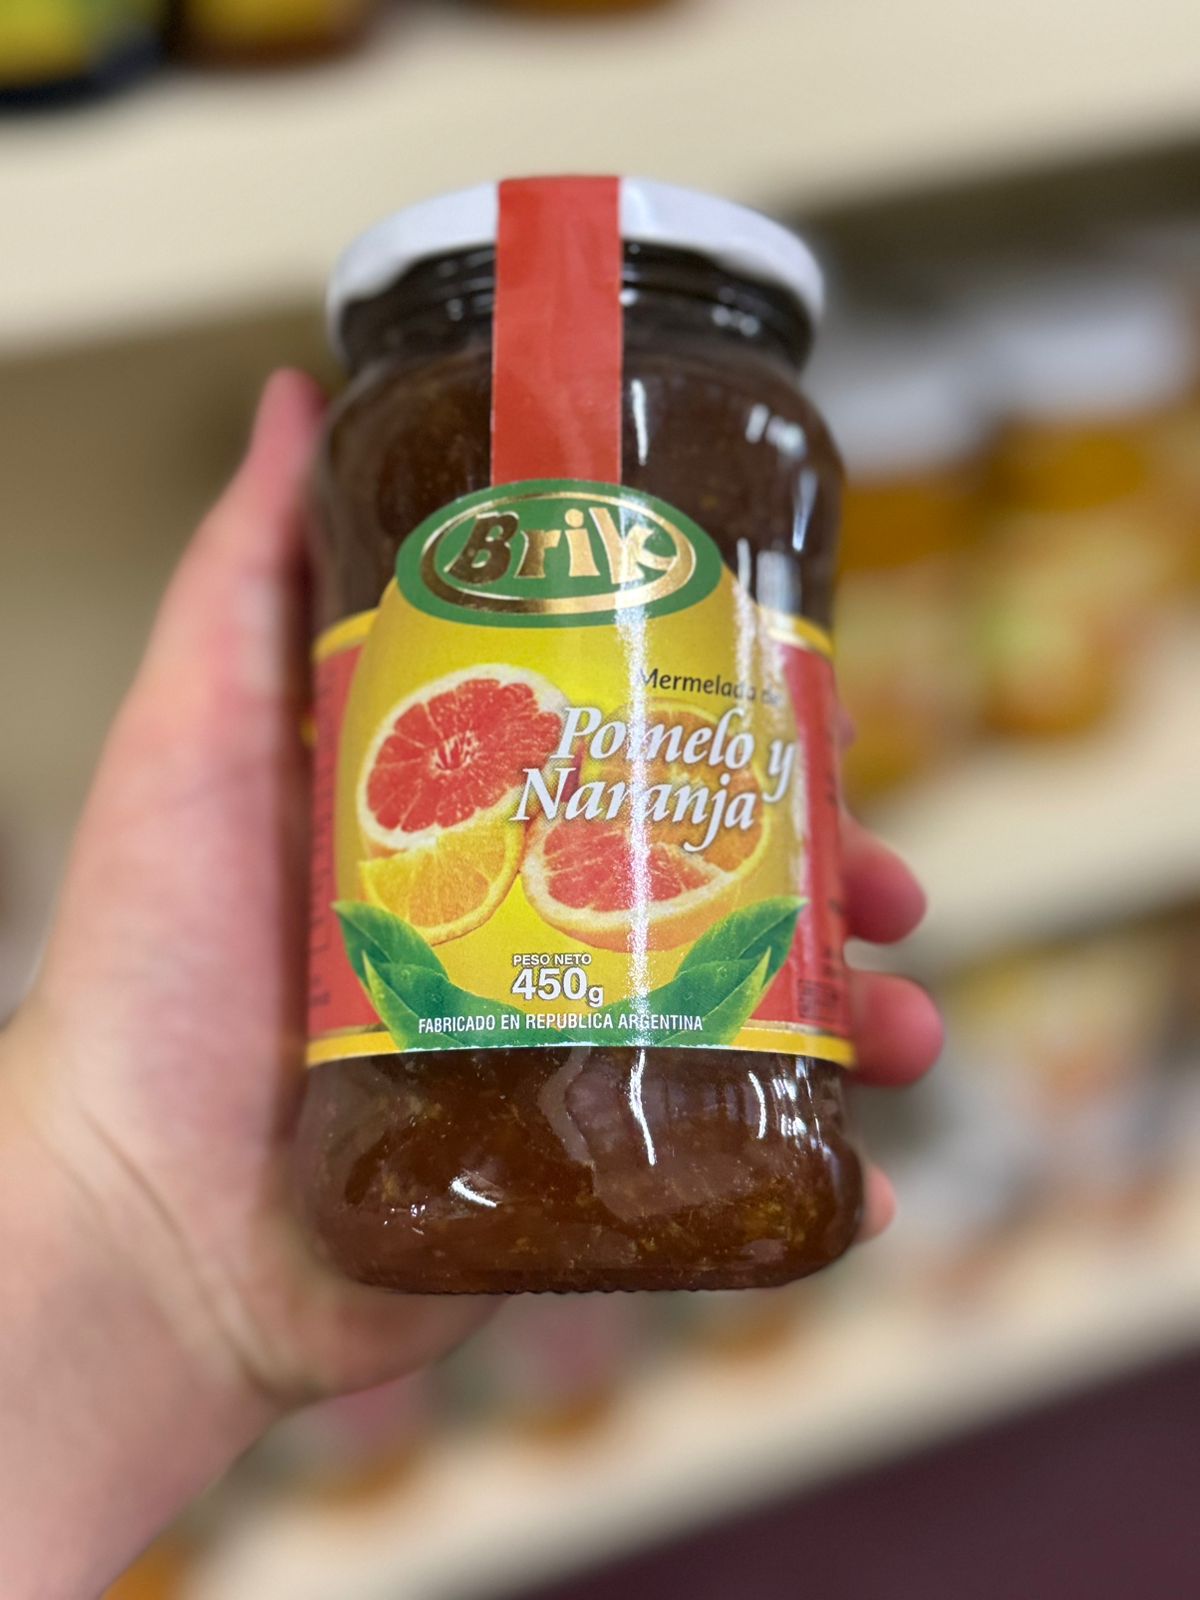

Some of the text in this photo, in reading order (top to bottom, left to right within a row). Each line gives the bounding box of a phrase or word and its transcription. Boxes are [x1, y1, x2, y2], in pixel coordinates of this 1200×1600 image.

[443, 507, 677, 586] Brik
[550, 706, 756, 769] Pomelo
[763, 739, 795, 802] y
[509, 767, 757, 852] Naranja
[511, 966, 604, 1006] 450g
[513, 954, 592, 966] PESO NETO
[418, 1012, 704, 1034] FABRICADO EN REPUBLICA ARGENTINA
